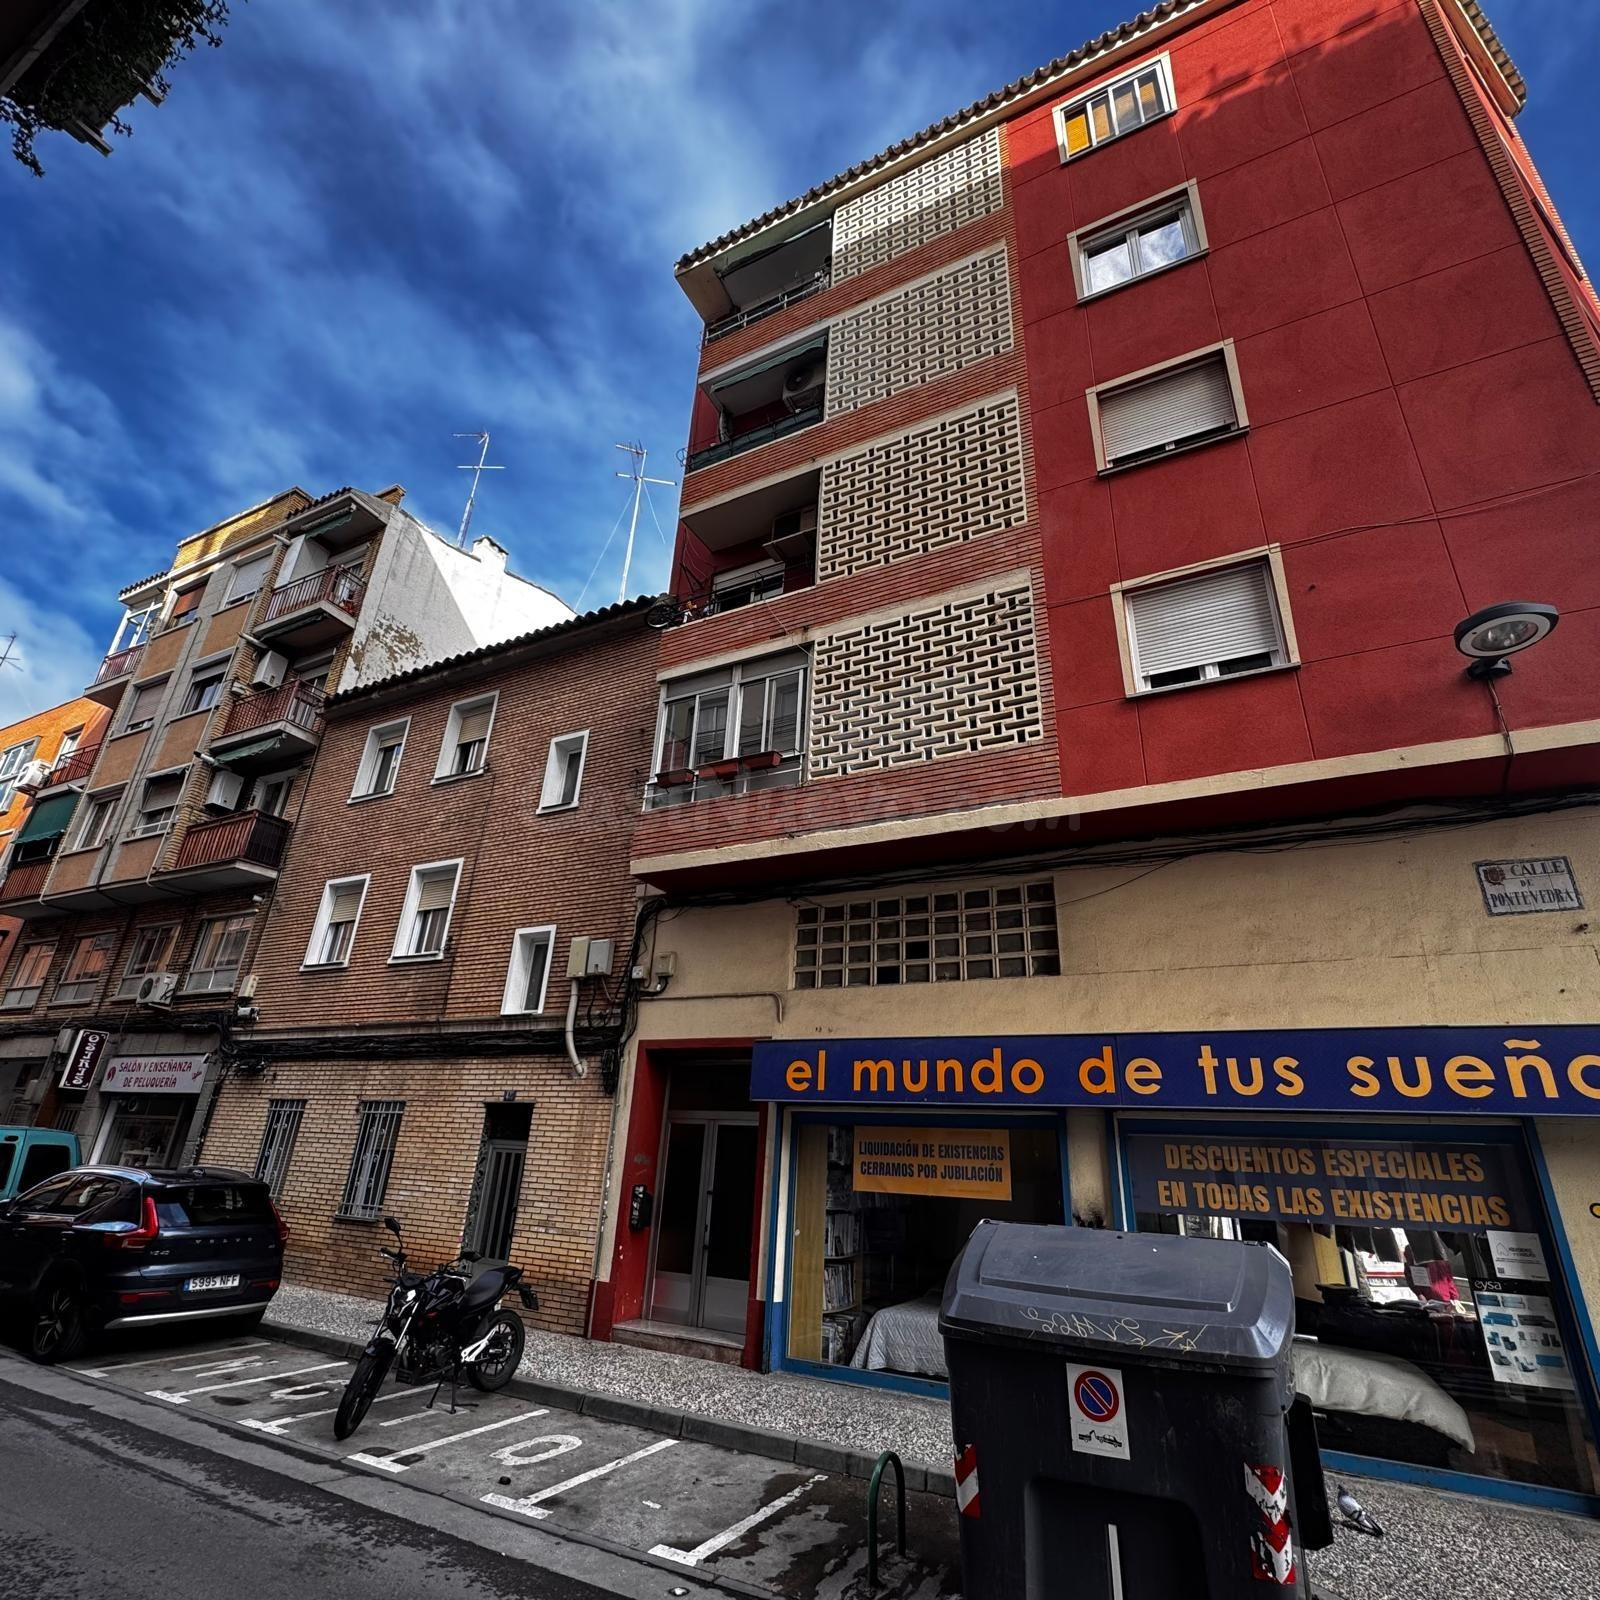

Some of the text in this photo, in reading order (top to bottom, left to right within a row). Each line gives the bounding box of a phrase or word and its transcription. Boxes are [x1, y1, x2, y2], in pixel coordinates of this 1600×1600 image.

[1510, 860, 1565, 877] CALLE
[1520, 879, 1534, 887] DE
[1490, 888, 1574, 908] PONTEVEDRA
[118, 1059, 193, 1073] SALÓN Y ENSEÑANZA
[785, 1049, 826, 1092] el
[852, 1047, 1045, 1094] mundo
[1078, 1045, 1163, 1095] de
[1197, 1045, 1304, 1097] tus
[122, 1077, 132, 1088] DE
[133, 1075, 178, 1088] PELUQUERÍA
[858, 1139, 1005, 1161] LIQUIDACIÓN DE EXISTENCIAS
[860, 1160, 1003, 1182] CERRAMOS POR JUBILACIÓN
[1164, 1143, 1485, 1182] DESCUENTOS ESPECIALES
[1157, 1180, 1511, 1227] EN TODAS LAS EXISTENCIAS
[191, 1275, 239, 1289] 5995 NFF
